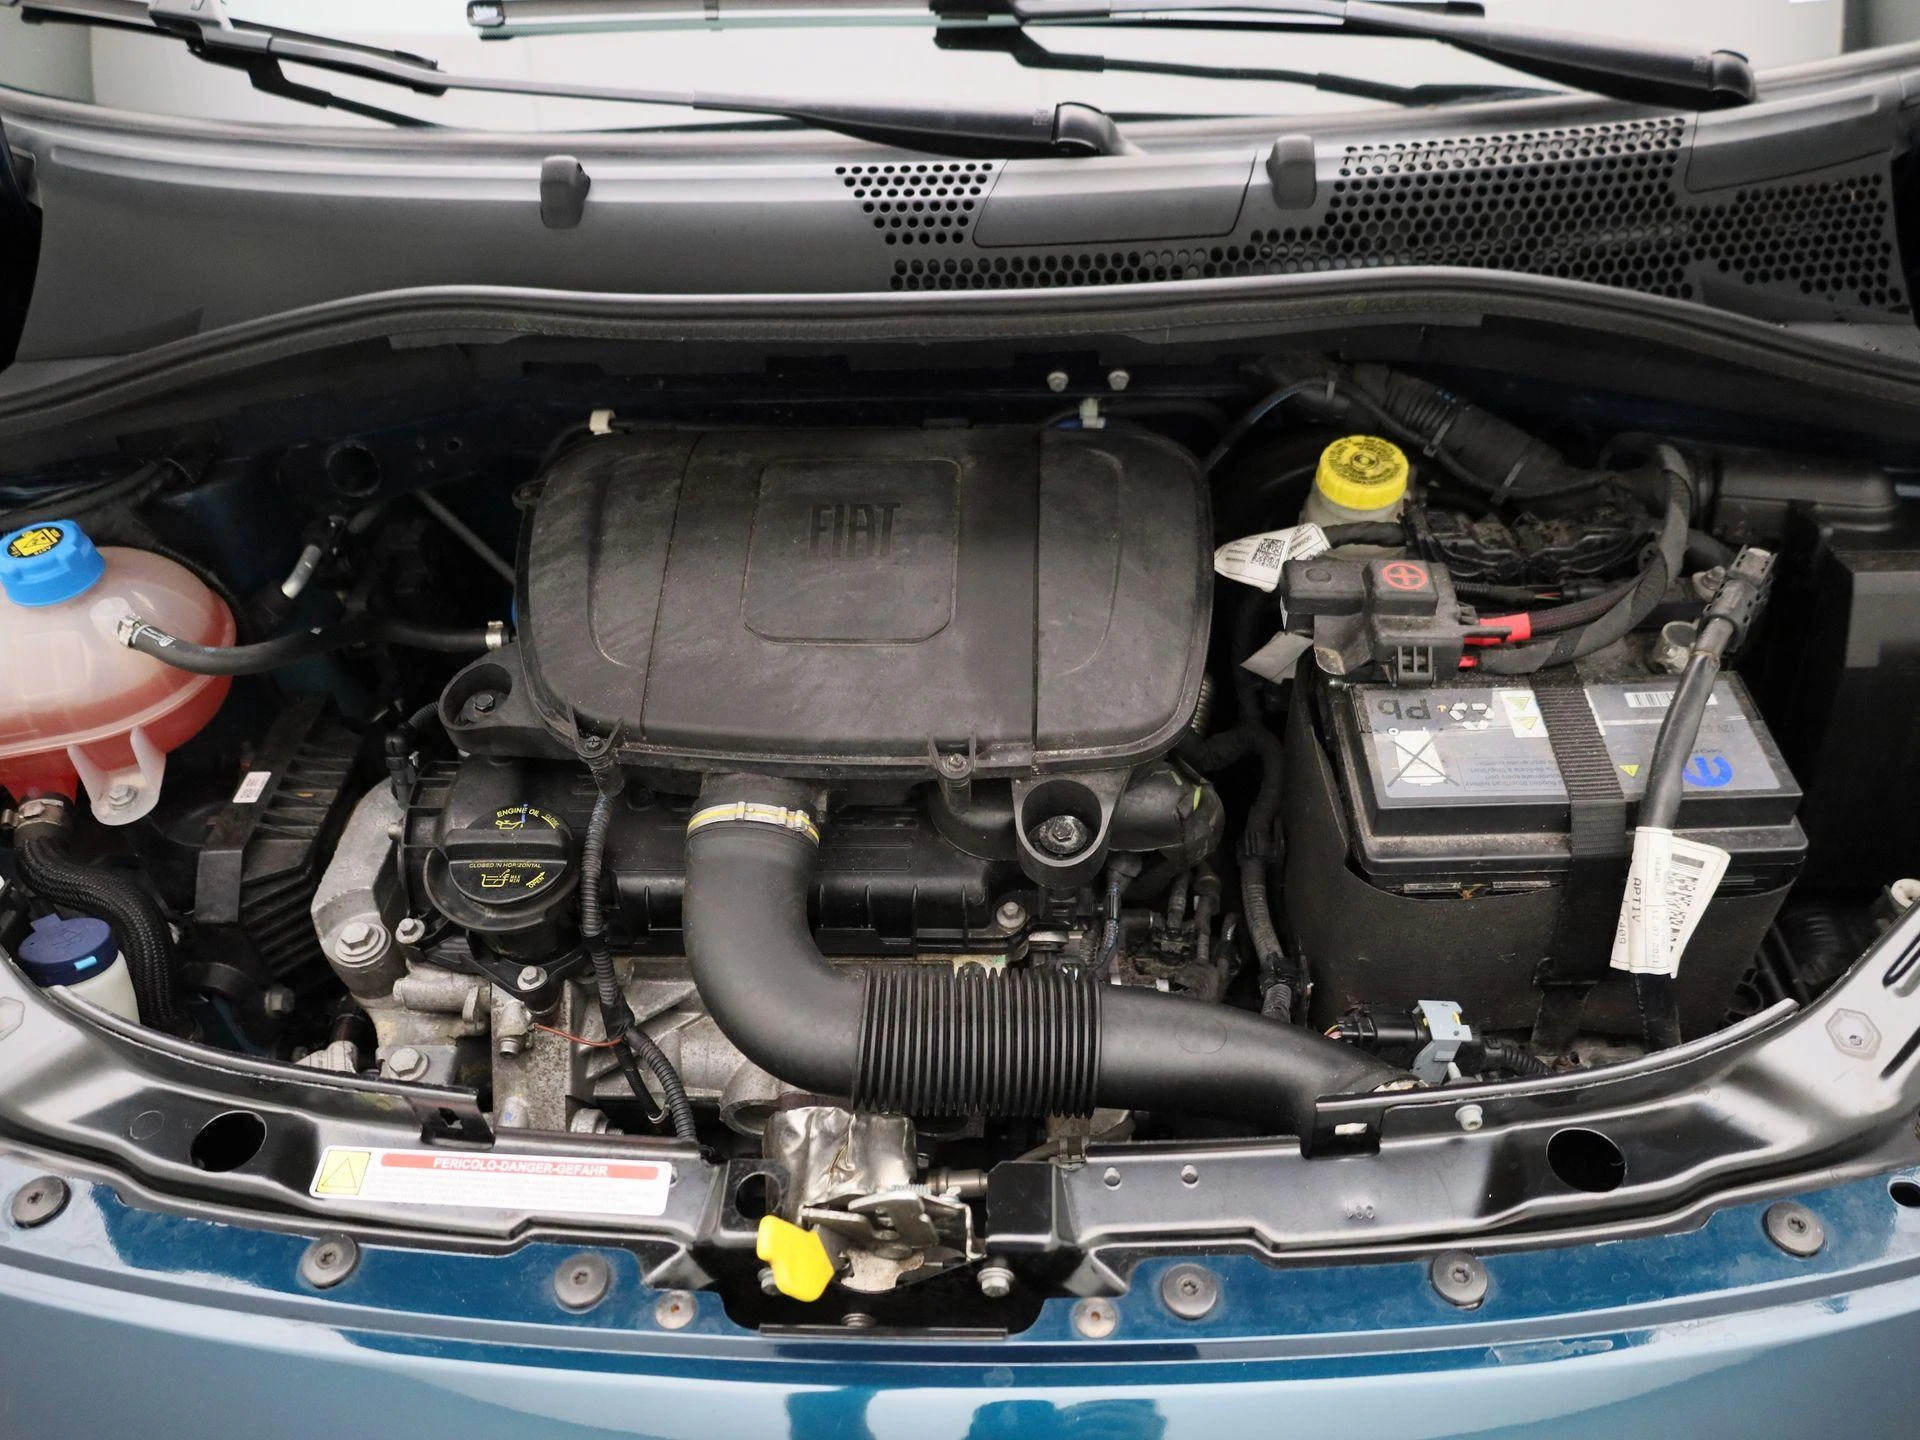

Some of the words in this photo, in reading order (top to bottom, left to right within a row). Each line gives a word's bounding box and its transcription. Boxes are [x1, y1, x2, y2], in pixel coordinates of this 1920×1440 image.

[808, 502, 902, 559] FIAT
[1377, 698, 1431, 720] Pb
[496, 808, 528, 818] ENGINE
[529, 808, 540, 818] OIL
[545, 813, 560, 828] CLOSE
[528, 876, 545, 889] OPEN
[1631, 877, 1642, 924] APTIV
[433, 1157, 609, 1176] PERICOLO-DANGER-GEFAHR
